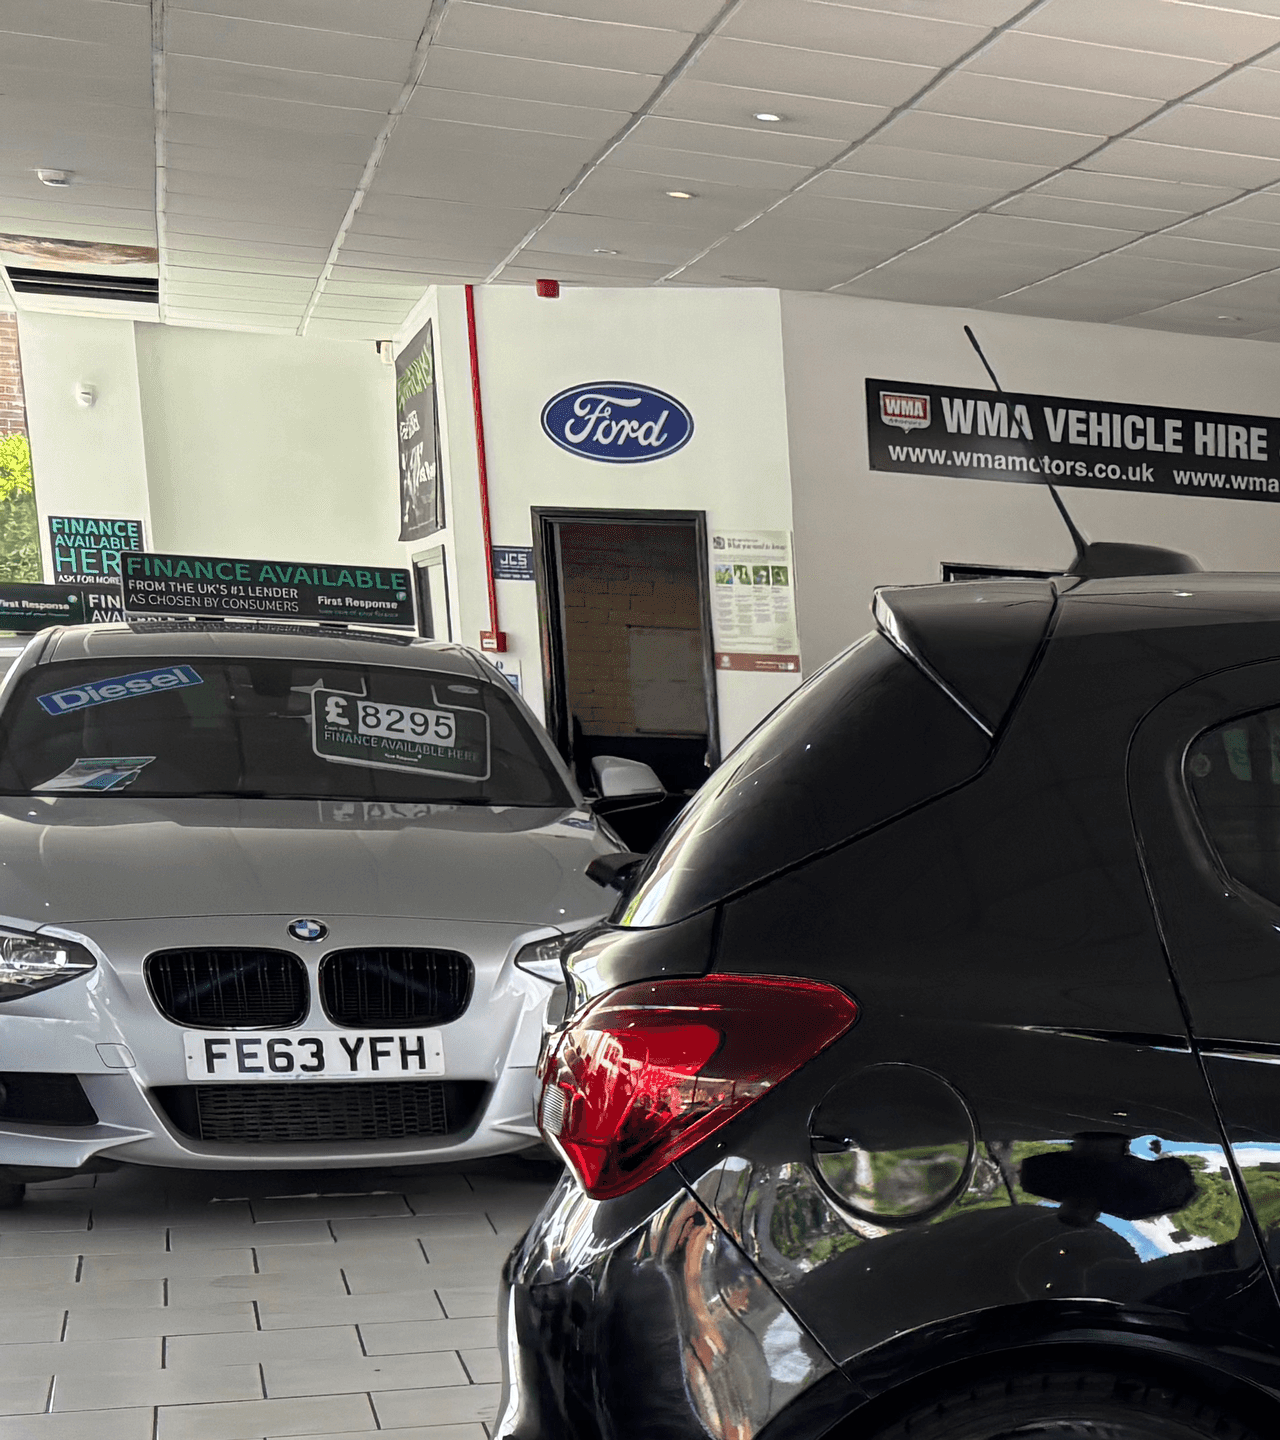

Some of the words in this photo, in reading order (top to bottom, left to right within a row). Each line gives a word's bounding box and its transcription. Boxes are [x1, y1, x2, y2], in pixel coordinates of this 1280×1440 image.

[565, 394, 669, 447] Ford
[885, 398, 924, 417] WMA
[941, 396, 1033, 440] WMA
[1043, 407, 1183, 453] VEHICLE
[1195, 421, 1268, 461] HIRE
[52, 518, 138, 537] FINANCE
[55, 534, 139, 550] AVAILABLE
[56, 547, 121, 574] HER
[127, 557, 250, 581] FINANCE
[259, 564, 407, 590] AVAILABLE
[58, 574, 76, 583] ASK
[77, 575, 95, 583] FOR
[129, 580, 165, 593] FROM
[169, 582, 194, 594] THE
[198, 583, 228, 595] UK'S
[230, 585, 245, 596] #1
[248, 585, 298, 599] LENDER
[129, 594, 146, 606] AS
[149, 594, 201, 608] CHOSEN
[204, 597, 220, 608] BY
[222, 598, 299, 612] CONSUMERS
[317, 595, 342, 606] First
[345, 597, 398, 609] Response
[51, 668, 190, 710] Diesel
[324, 696, 350, 725] £
[361, 705, 453, 739] 8295
[324, 731, 378, 748] FINANCE
[380, 738, 445, 758] AVAILABLE
[447, 748, 479, 762] HERE
[204, 1037, 325, 1073] FE63
[339, 1035, 427, 1071] YFH
